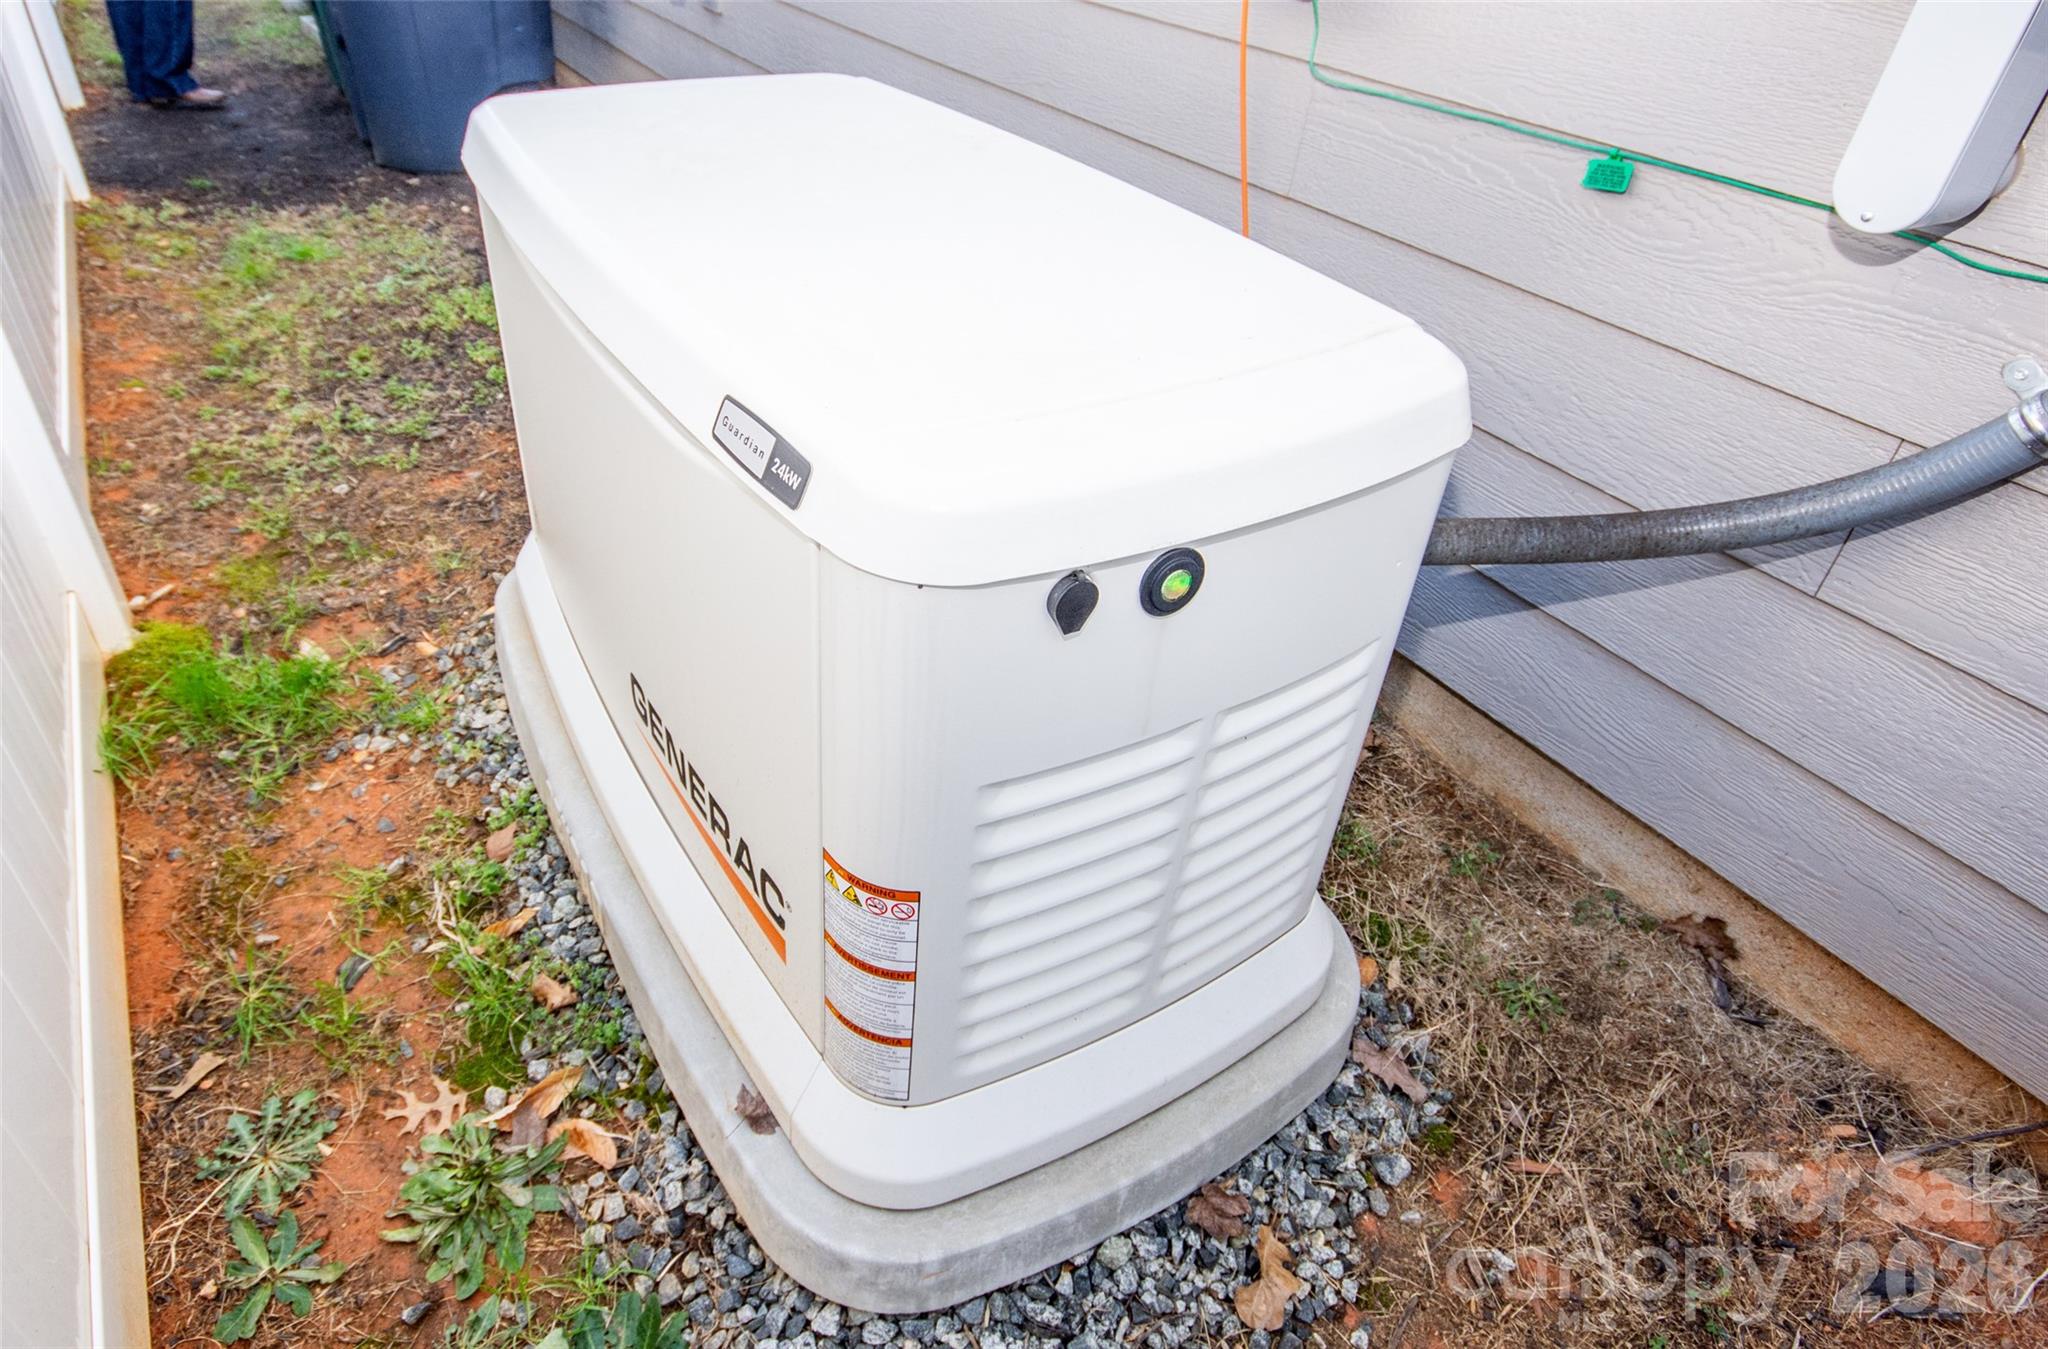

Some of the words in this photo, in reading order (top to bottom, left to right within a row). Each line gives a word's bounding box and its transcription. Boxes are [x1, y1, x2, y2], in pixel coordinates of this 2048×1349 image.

[722, 415, 765, 459] Guardian
[771, 457, 802, 490] 24kW
[630, 671, 786, 931] GENERAC
[846, 873, 896, 899] WARNING
